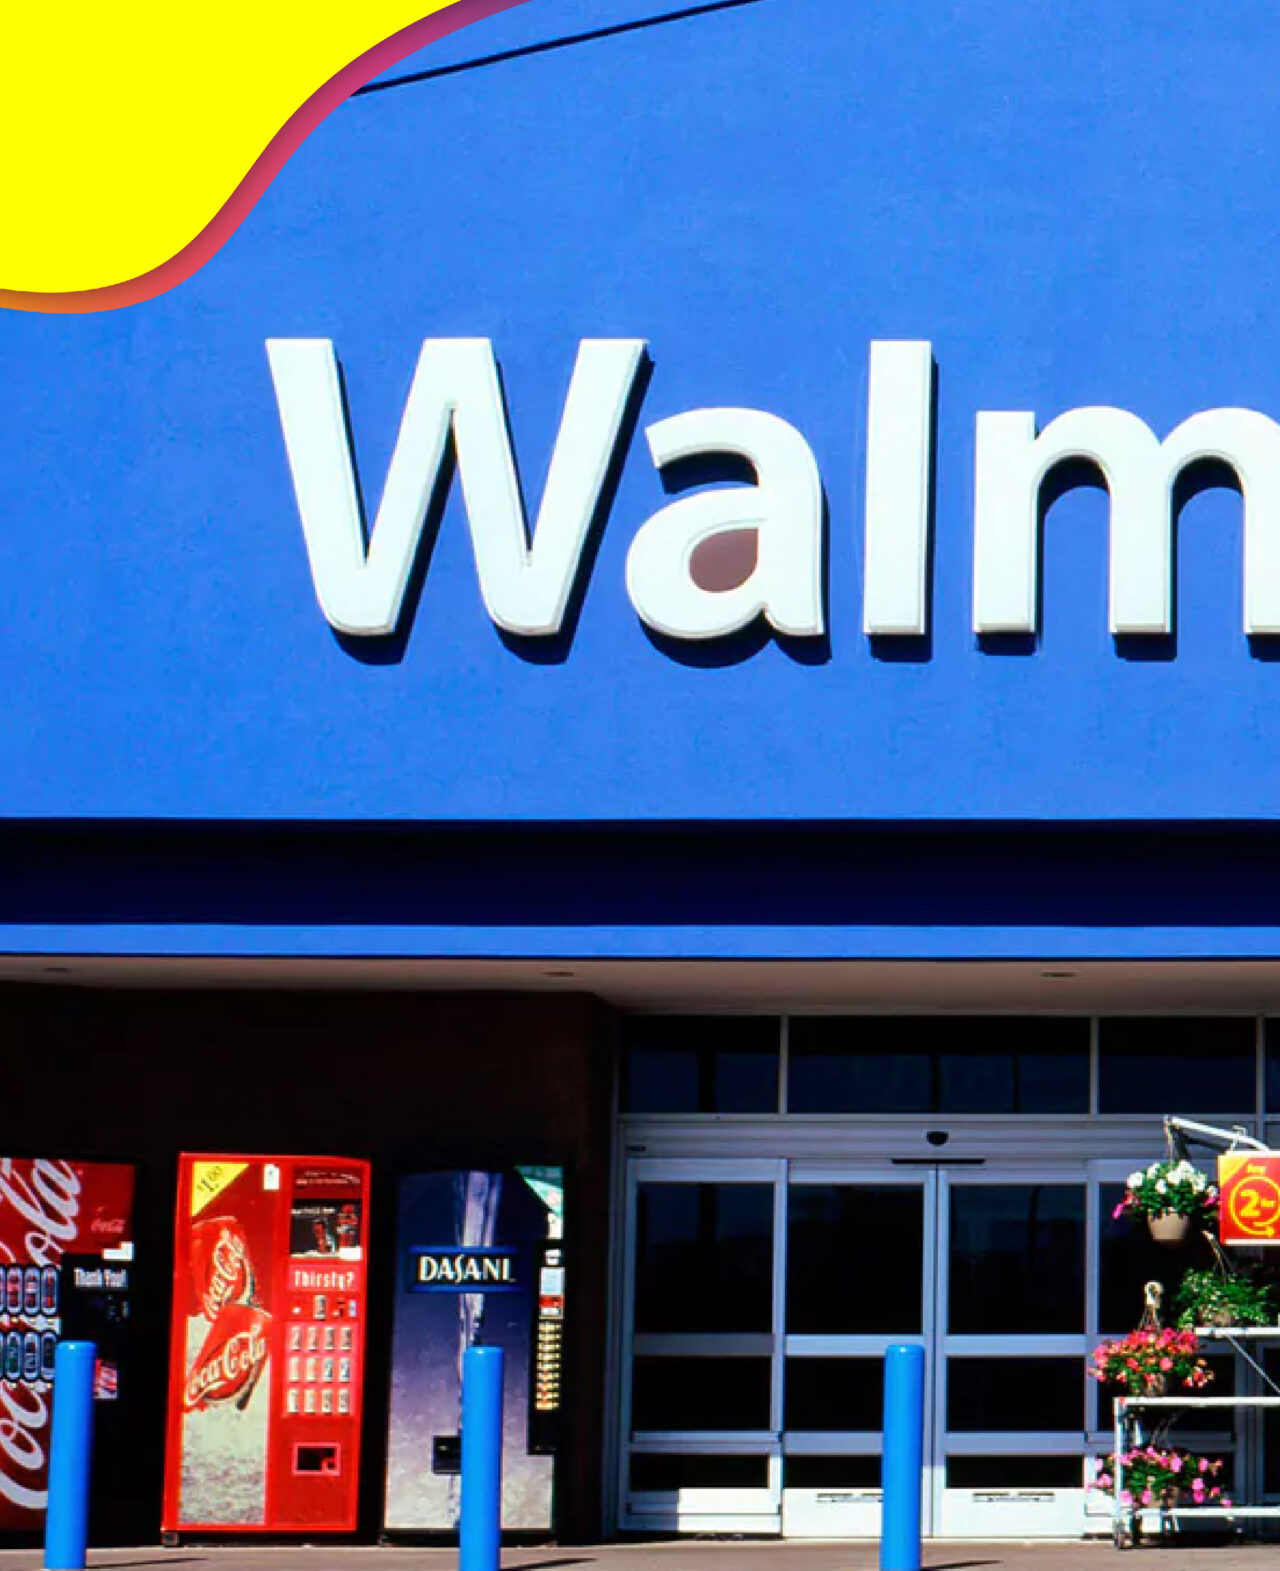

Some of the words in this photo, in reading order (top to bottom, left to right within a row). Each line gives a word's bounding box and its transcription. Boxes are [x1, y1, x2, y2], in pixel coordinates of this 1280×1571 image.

[1239, 1189, 1261, 1217] 2
[294, 1270, 356, 1291] Thirsty?
[418, 1254, 511, 1284] DASANI
